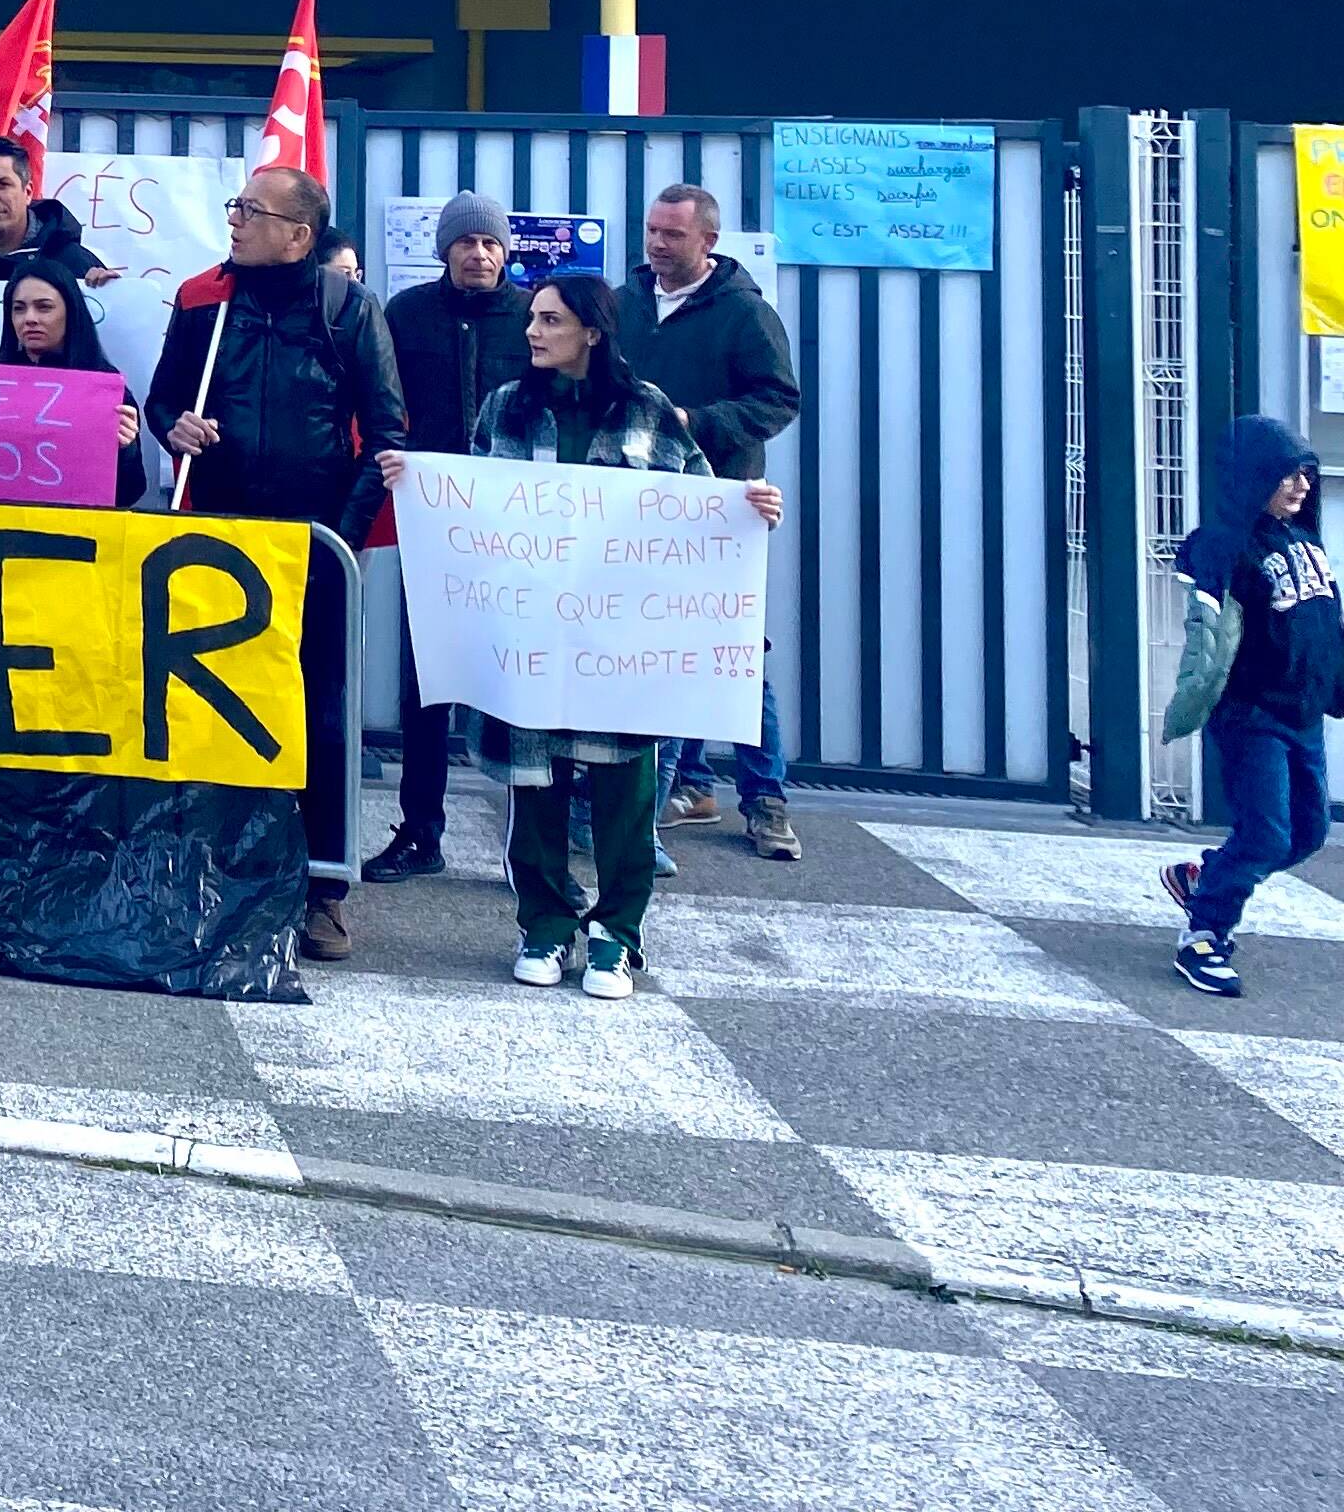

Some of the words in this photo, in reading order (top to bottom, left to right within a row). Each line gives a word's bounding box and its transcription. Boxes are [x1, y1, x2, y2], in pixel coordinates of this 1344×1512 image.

[780, 126, 911, 149] ENSEIGNANTS
[784, 156, 867, 175] CLASSES
[785, 182, 855, 201] ELEVES
[811, 223, 869, 238] C'EST
[417, 470, 476, 511] UN
[503, 478, 605, 521] AESH
[638, 486, 728, 524] POUR
[447, 525, 578, 569] CHAQUE
[441, 572, 534, 620] PARCE
[555, 591, 624, 627] QUE
[639, 592, 757, 628] CHAQUE
[492, 638, 550, 678] VIE
[574, 649, 699, 678] COMPTE
